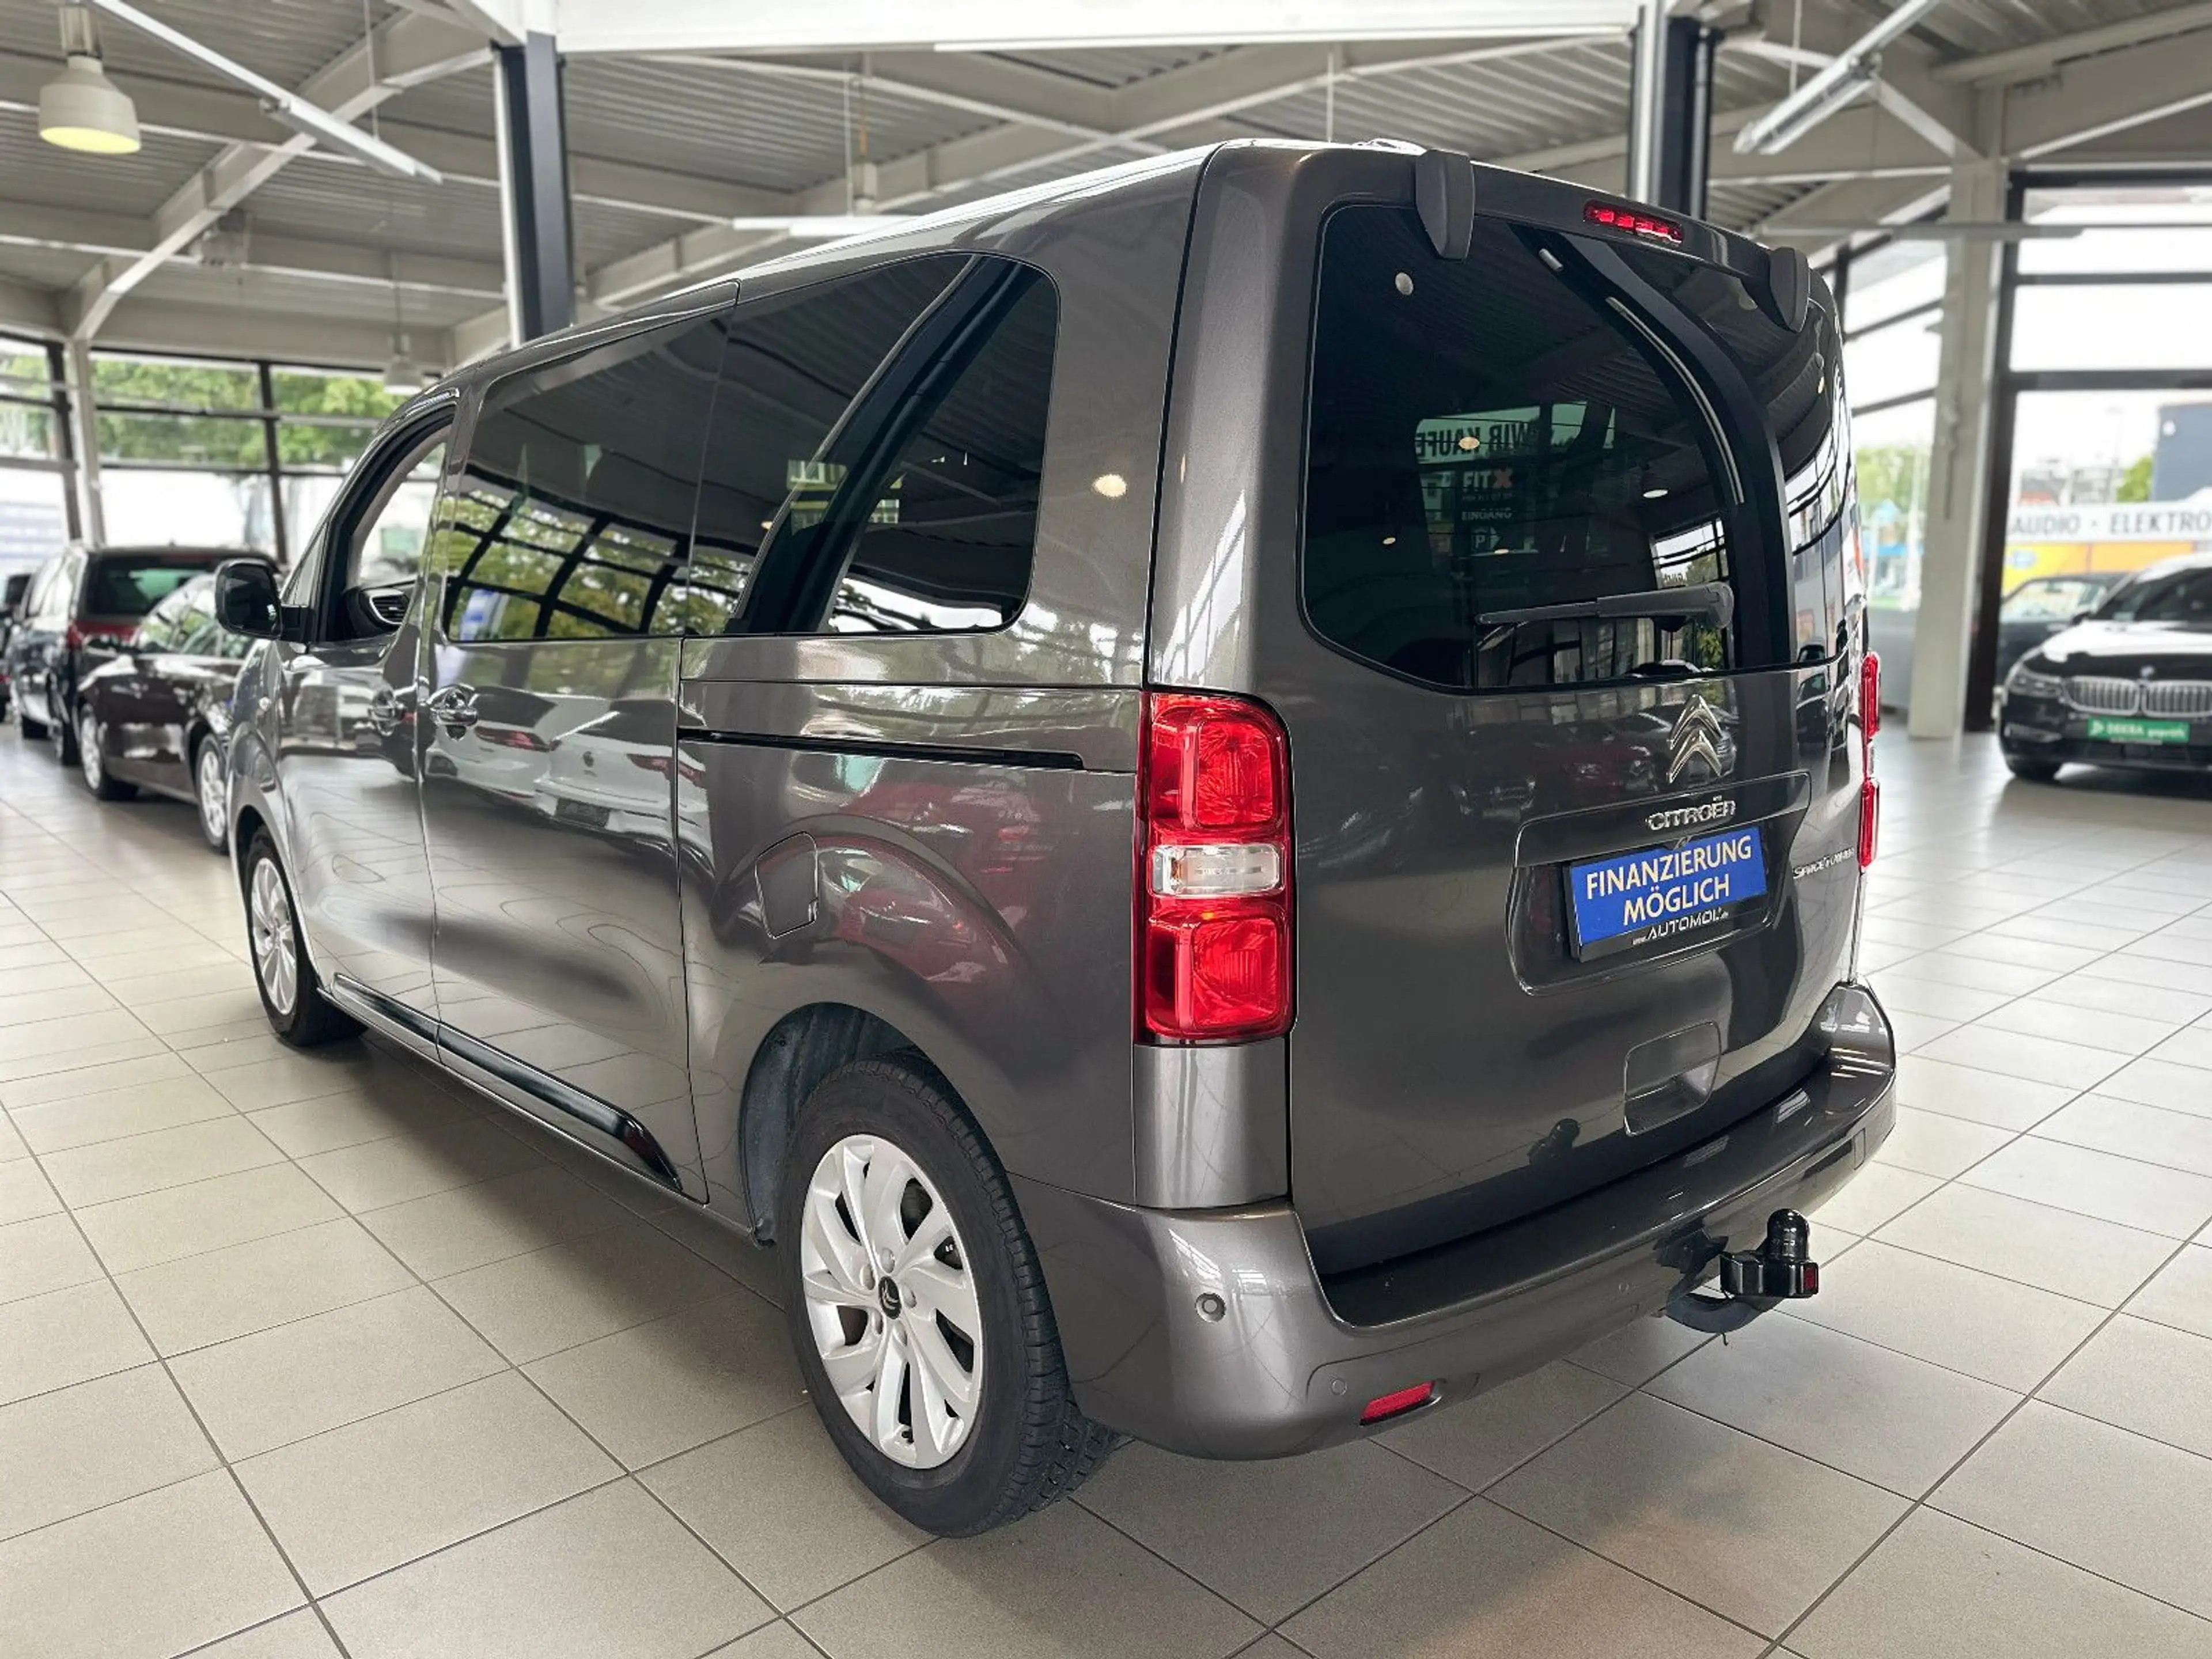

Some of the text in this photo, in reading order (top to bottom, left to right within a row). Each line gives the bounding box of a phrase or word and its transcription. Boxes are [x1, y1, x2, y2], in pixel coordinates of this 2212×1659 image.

[2012, 514, 2081, 535] AUDIO
[1646, 796, 1736, 831] CITROËN
[1587, 836, 1751, 900] FINANZIERUNG
[1623, 873, 1730, 926] MÖGLICH
